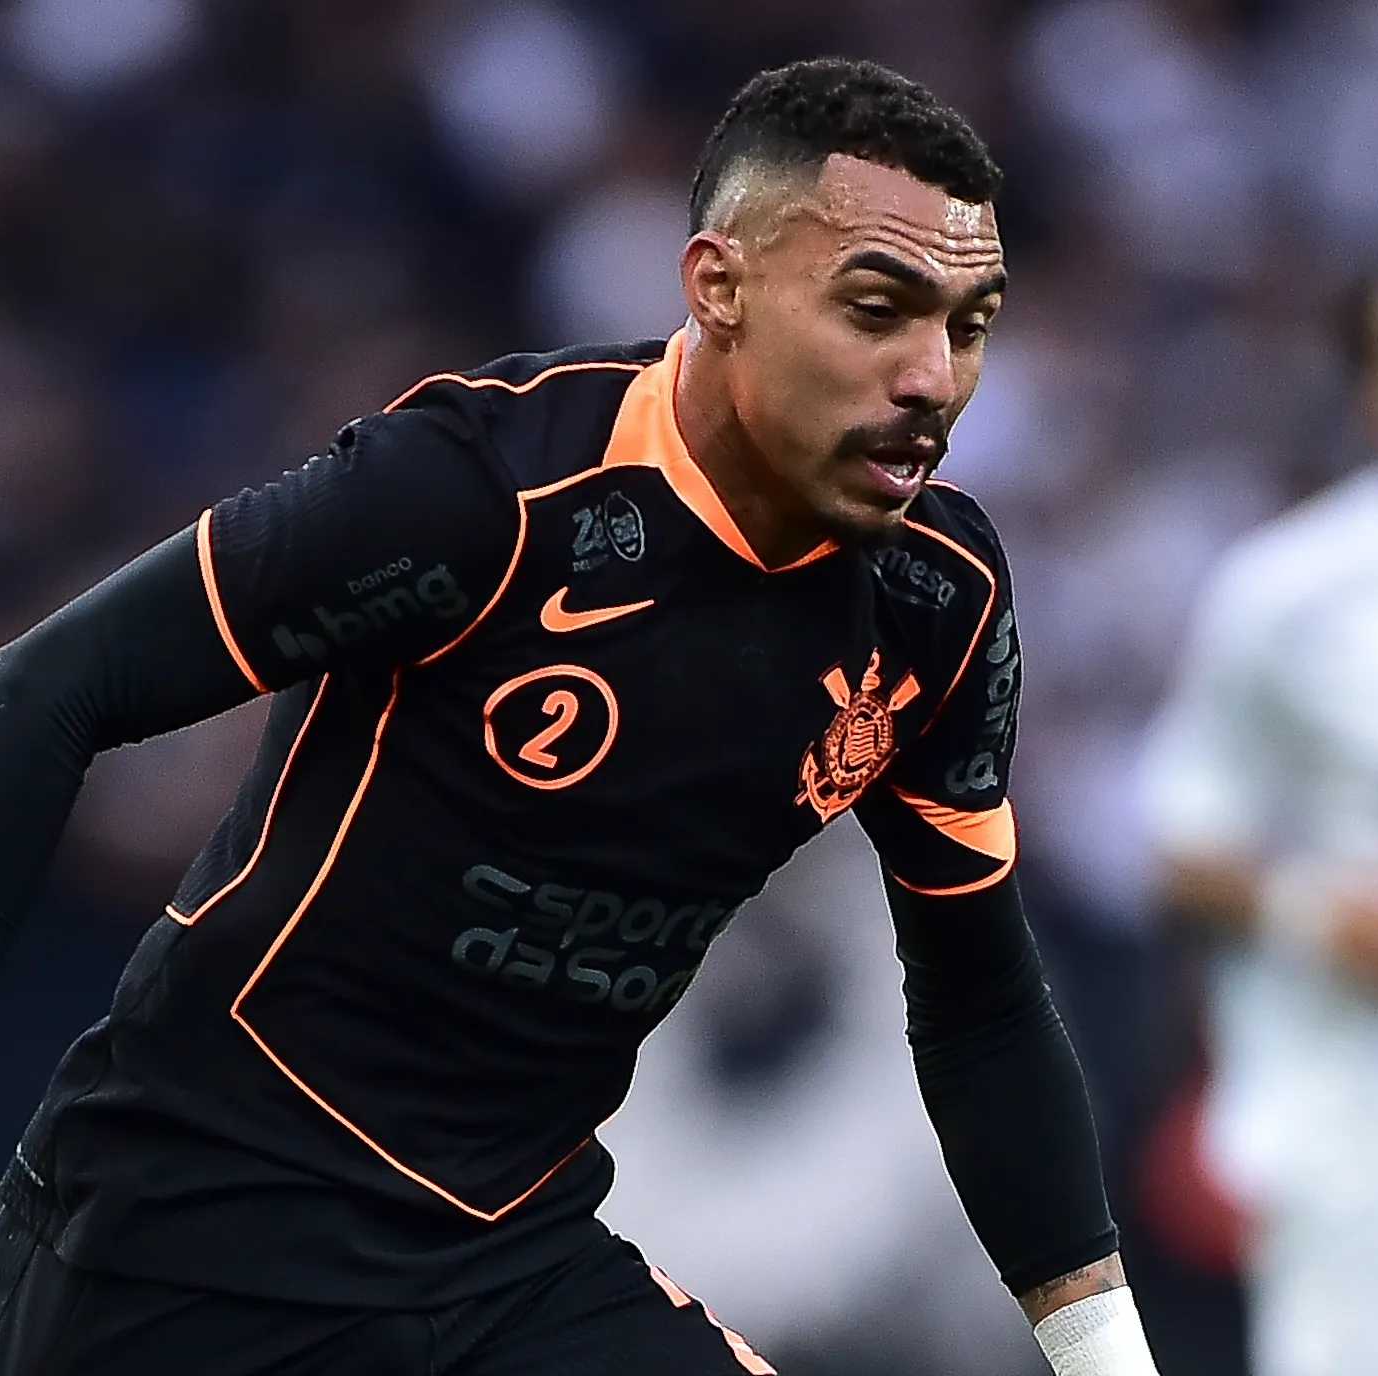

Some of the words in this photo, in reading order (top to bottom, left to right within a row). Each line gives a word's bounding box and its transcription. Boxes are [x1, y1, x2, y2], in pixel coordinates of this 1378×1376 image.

[313, 562, 471, 647] bmg
[346, 555, 413, 596] banco
[874, 547, 957, 608] mesa
[518, 689, 579, 769] 2
[461, 861, 735, 952] Esport
[565, 946, 699, 1013] Sor
